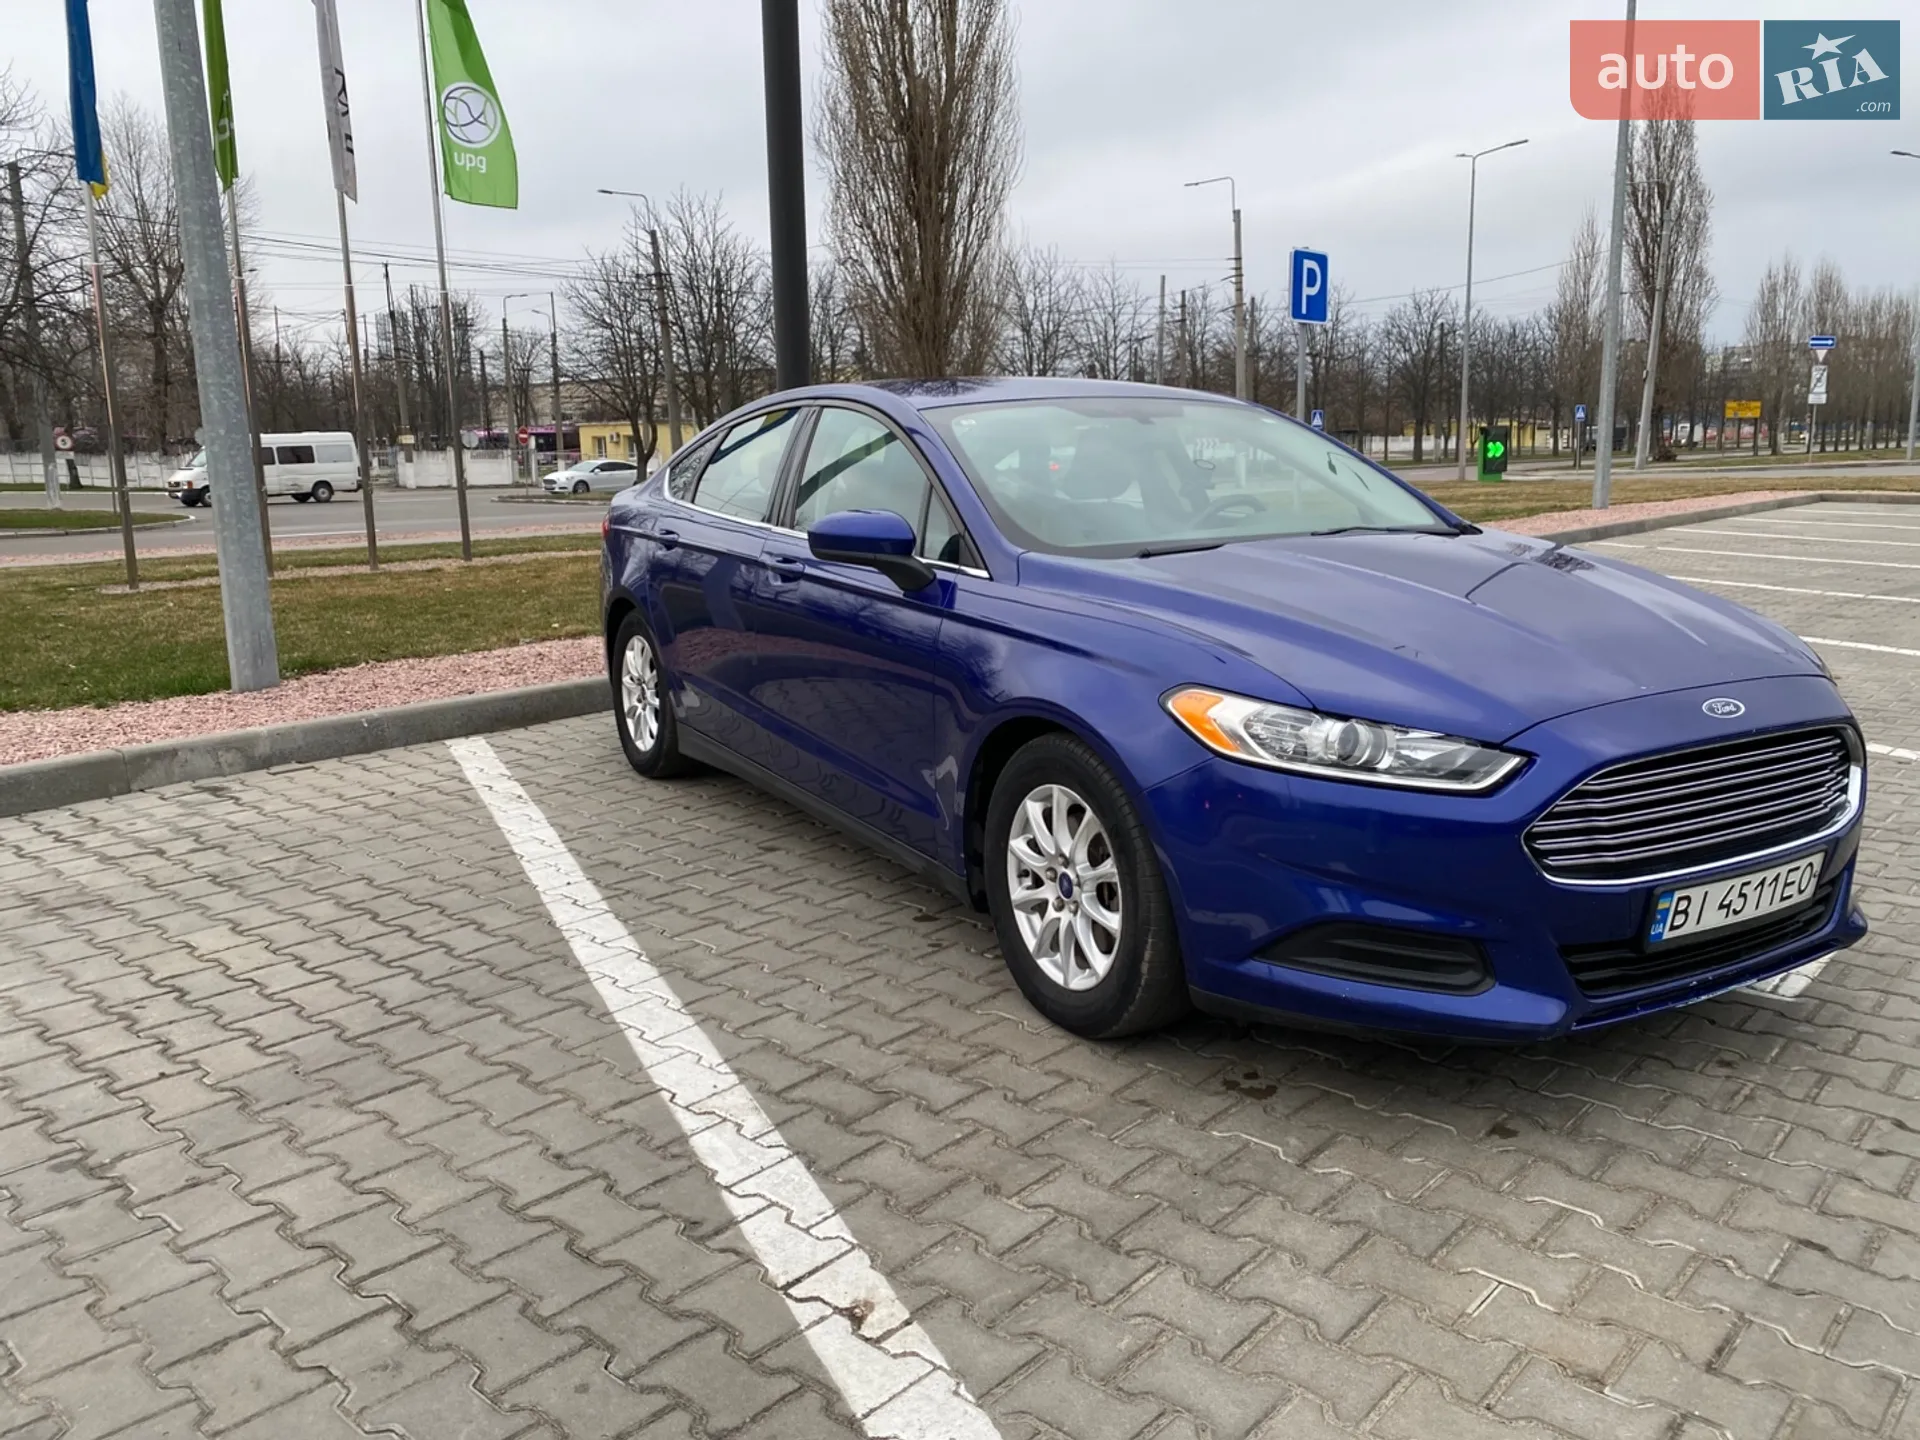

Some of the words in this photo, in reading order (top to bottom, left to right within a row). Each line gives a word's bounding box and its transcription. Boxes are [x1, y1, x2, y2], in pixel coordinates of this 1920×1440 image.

[454, 152, 486, 173] upg
[1301, 258, 1321, 314] P
[1711, 701, 1738, 714] Ford
[1668, 890, 1708, 932] BI
[1651, 922, 1664, 935] UA
